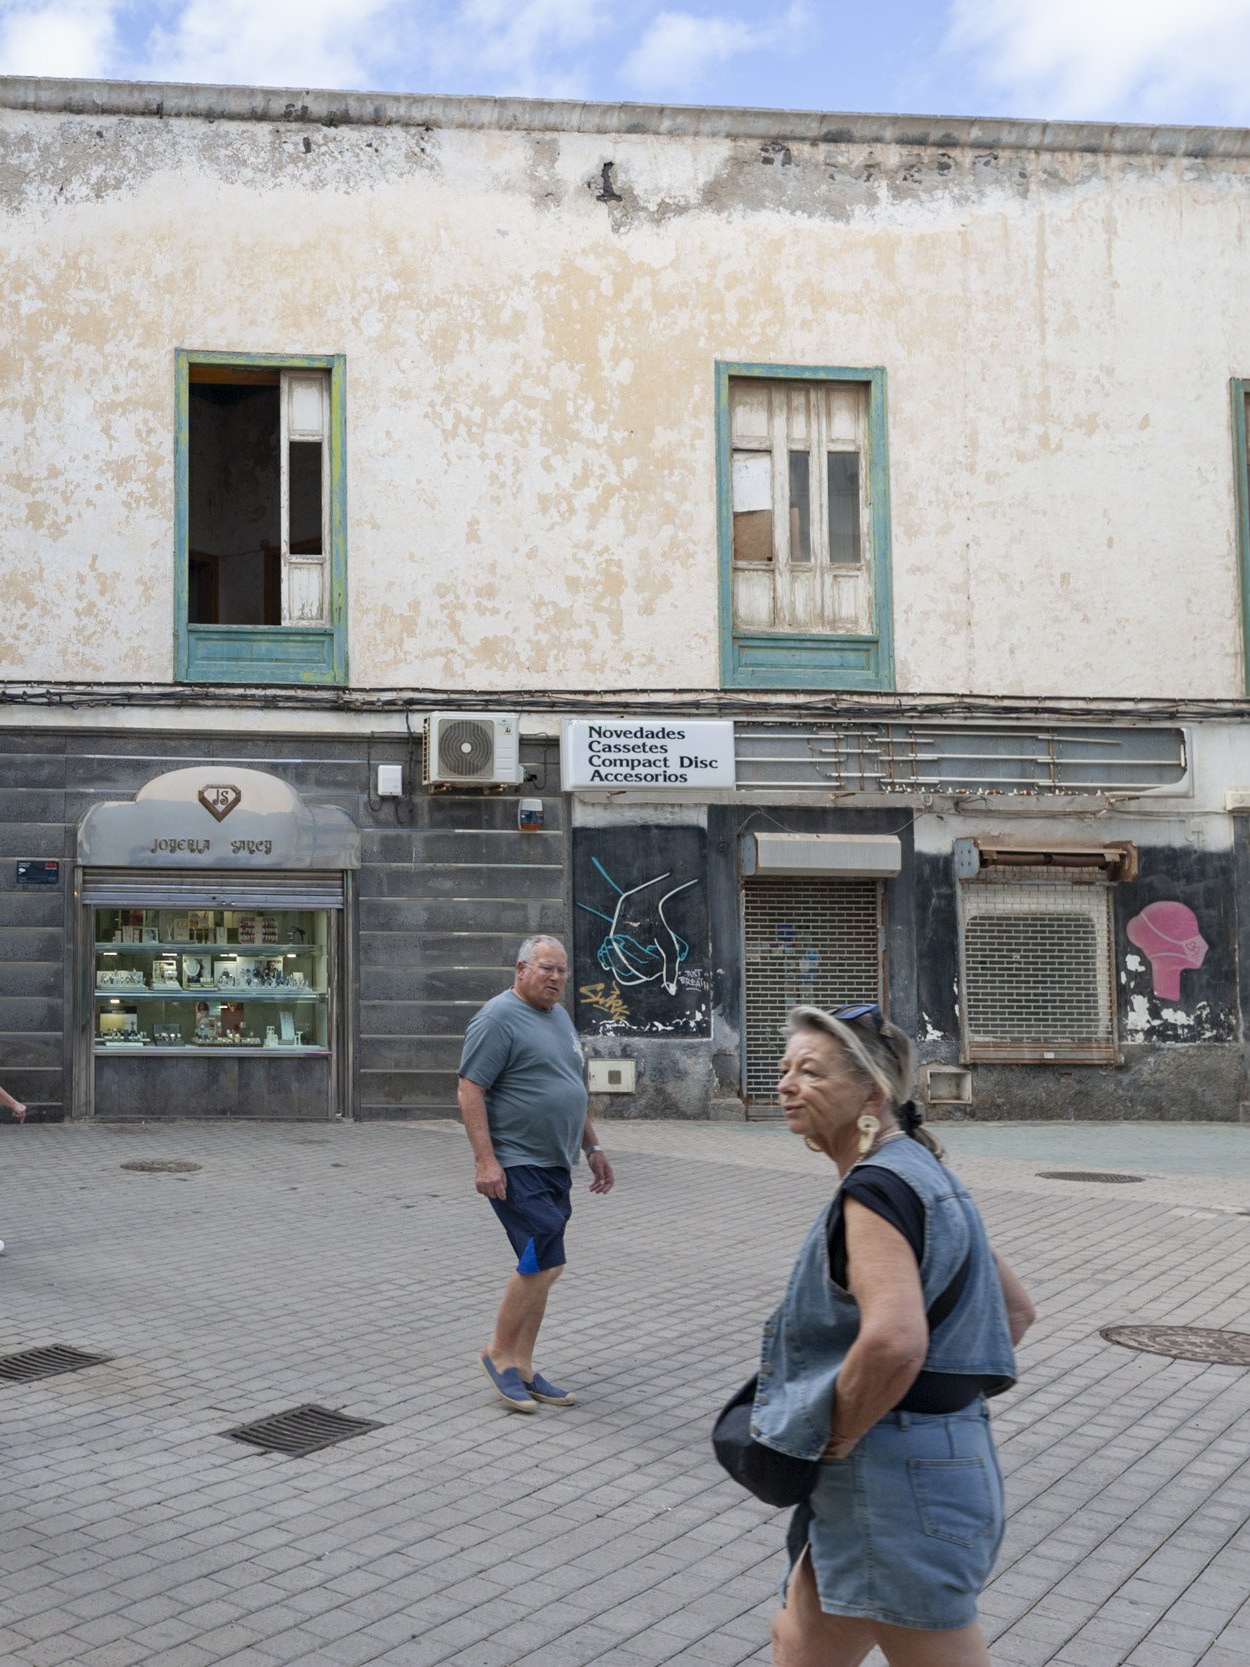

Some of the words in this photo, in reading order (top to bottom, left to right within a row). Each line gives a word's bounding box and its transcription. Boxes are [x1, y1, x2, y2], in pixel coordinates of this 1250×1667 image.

[588, 726, 686, 740] Novedades
[588, 740, 668, 754] Cassetes
[588, 755, 670, 770] Compact
[679, 756, 718, 769] Disc
[590, 770, 688, 783] Accesorios
